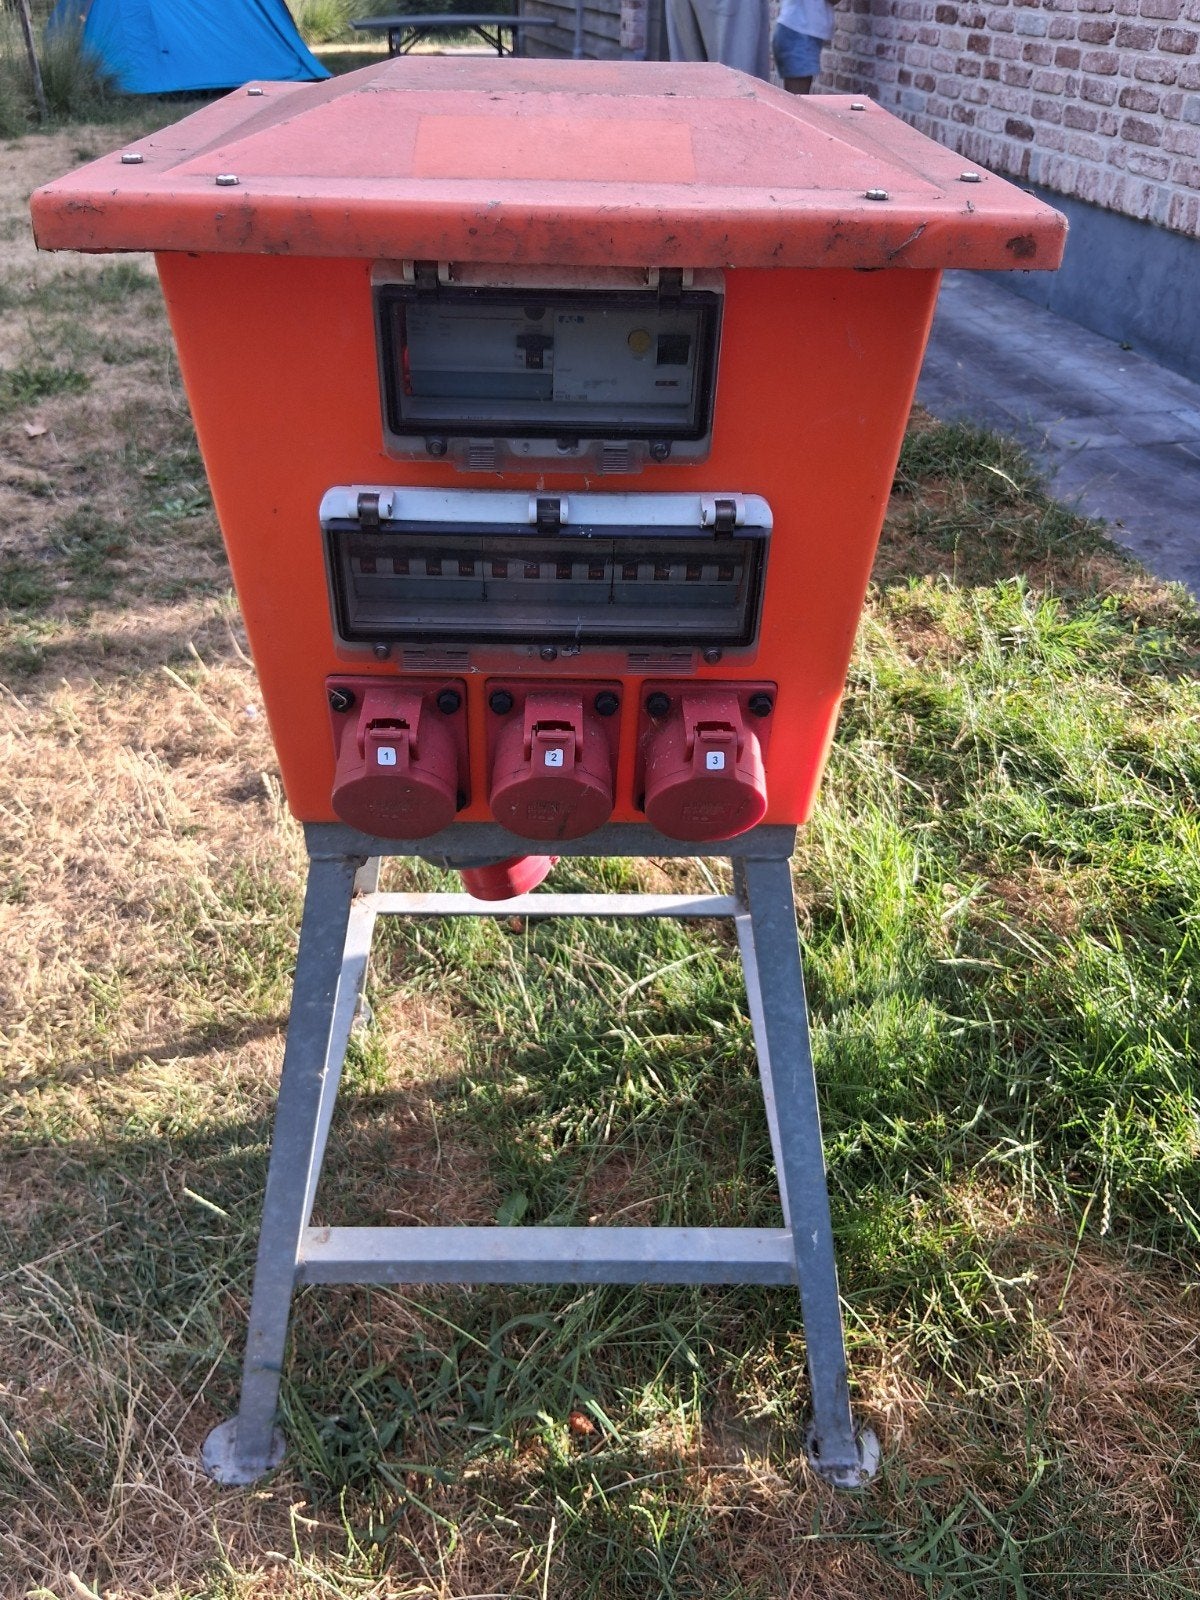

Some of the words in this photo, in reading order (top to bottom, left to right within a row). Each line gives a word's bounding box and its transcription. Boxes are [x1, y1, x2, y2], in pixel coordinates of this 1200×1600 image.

[383, 752, 389, 761] 1
[550, 752, 558, 762] 2
[712, 756, 719, 765] 3
